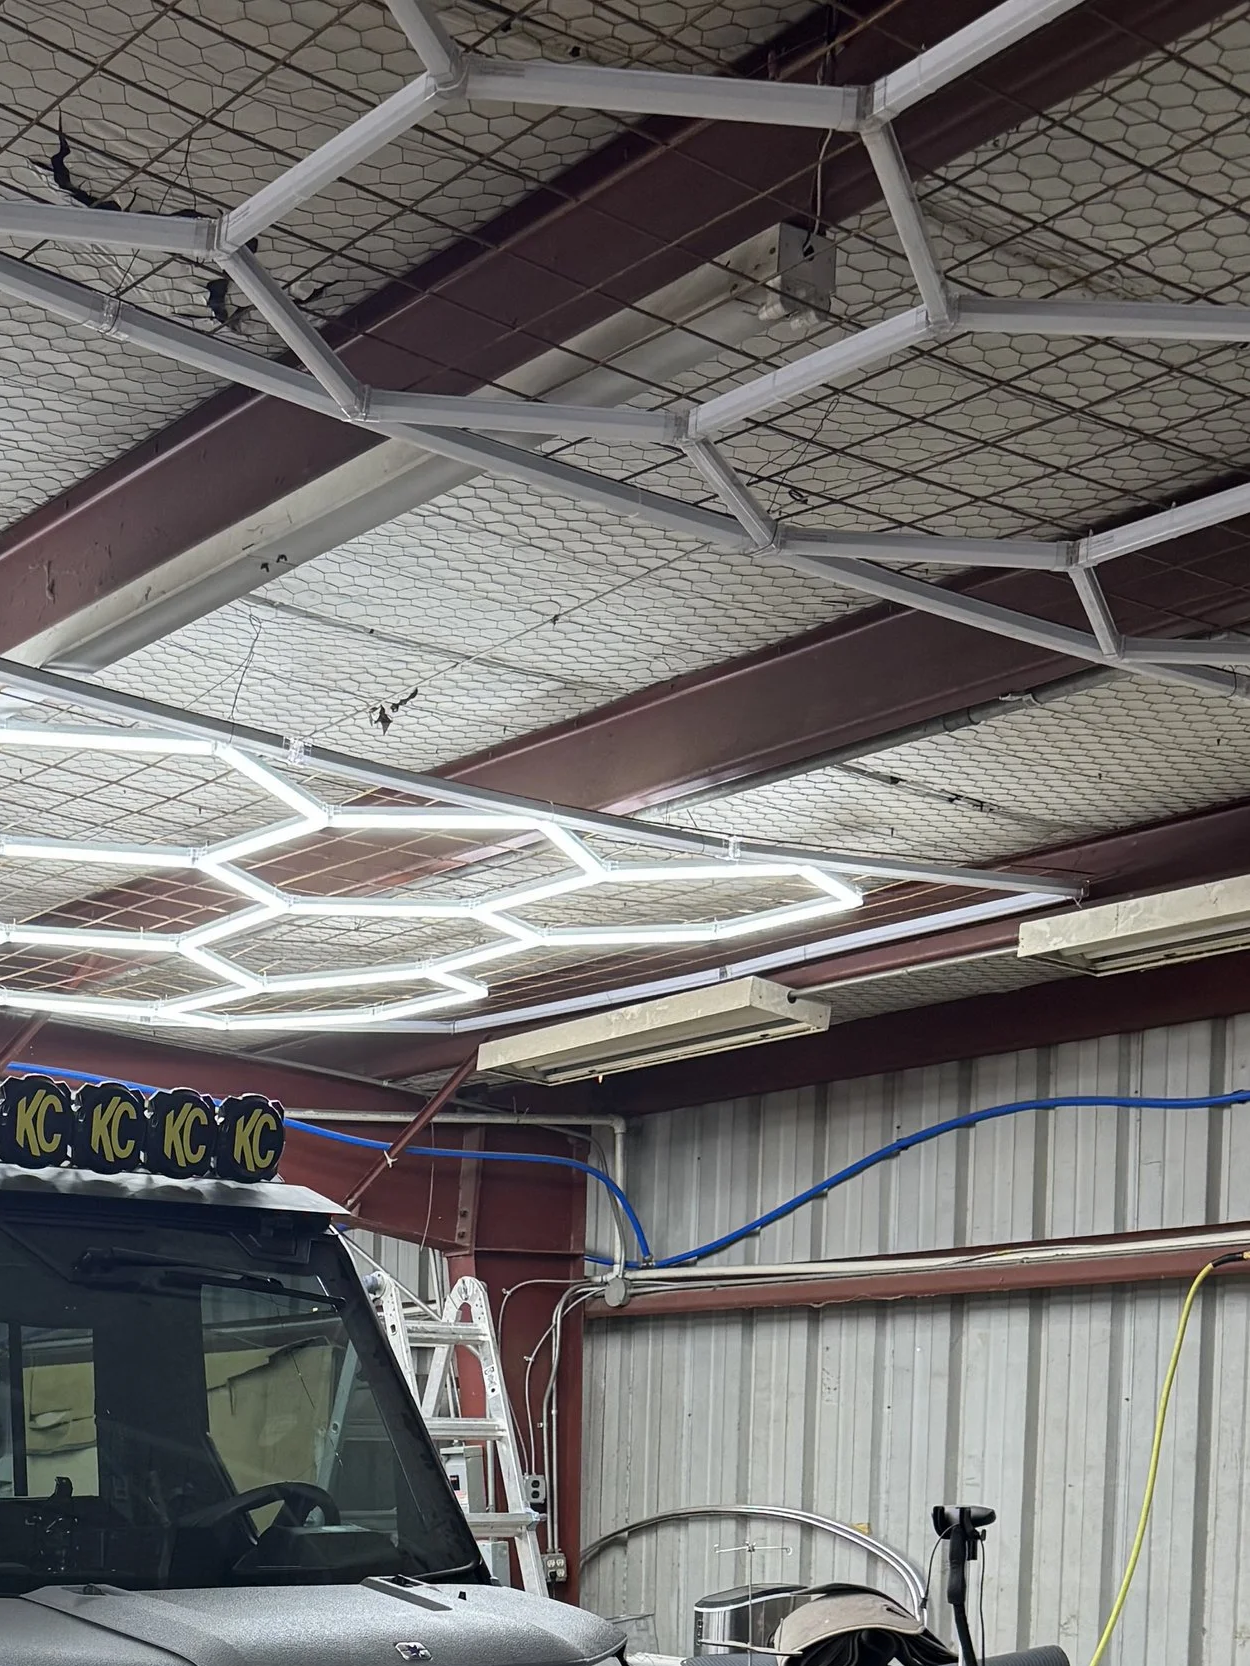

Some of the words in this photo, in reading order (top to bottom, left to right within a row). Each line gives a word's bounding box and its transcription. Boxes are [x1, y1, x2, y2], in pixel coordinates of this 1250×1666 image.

[16, 1090, 61, 1155] KC
[92, 1097, 136, 1161] KC
[165, 1103, 206, 1166] KC
[235, 1109, 276, 1168] KC
